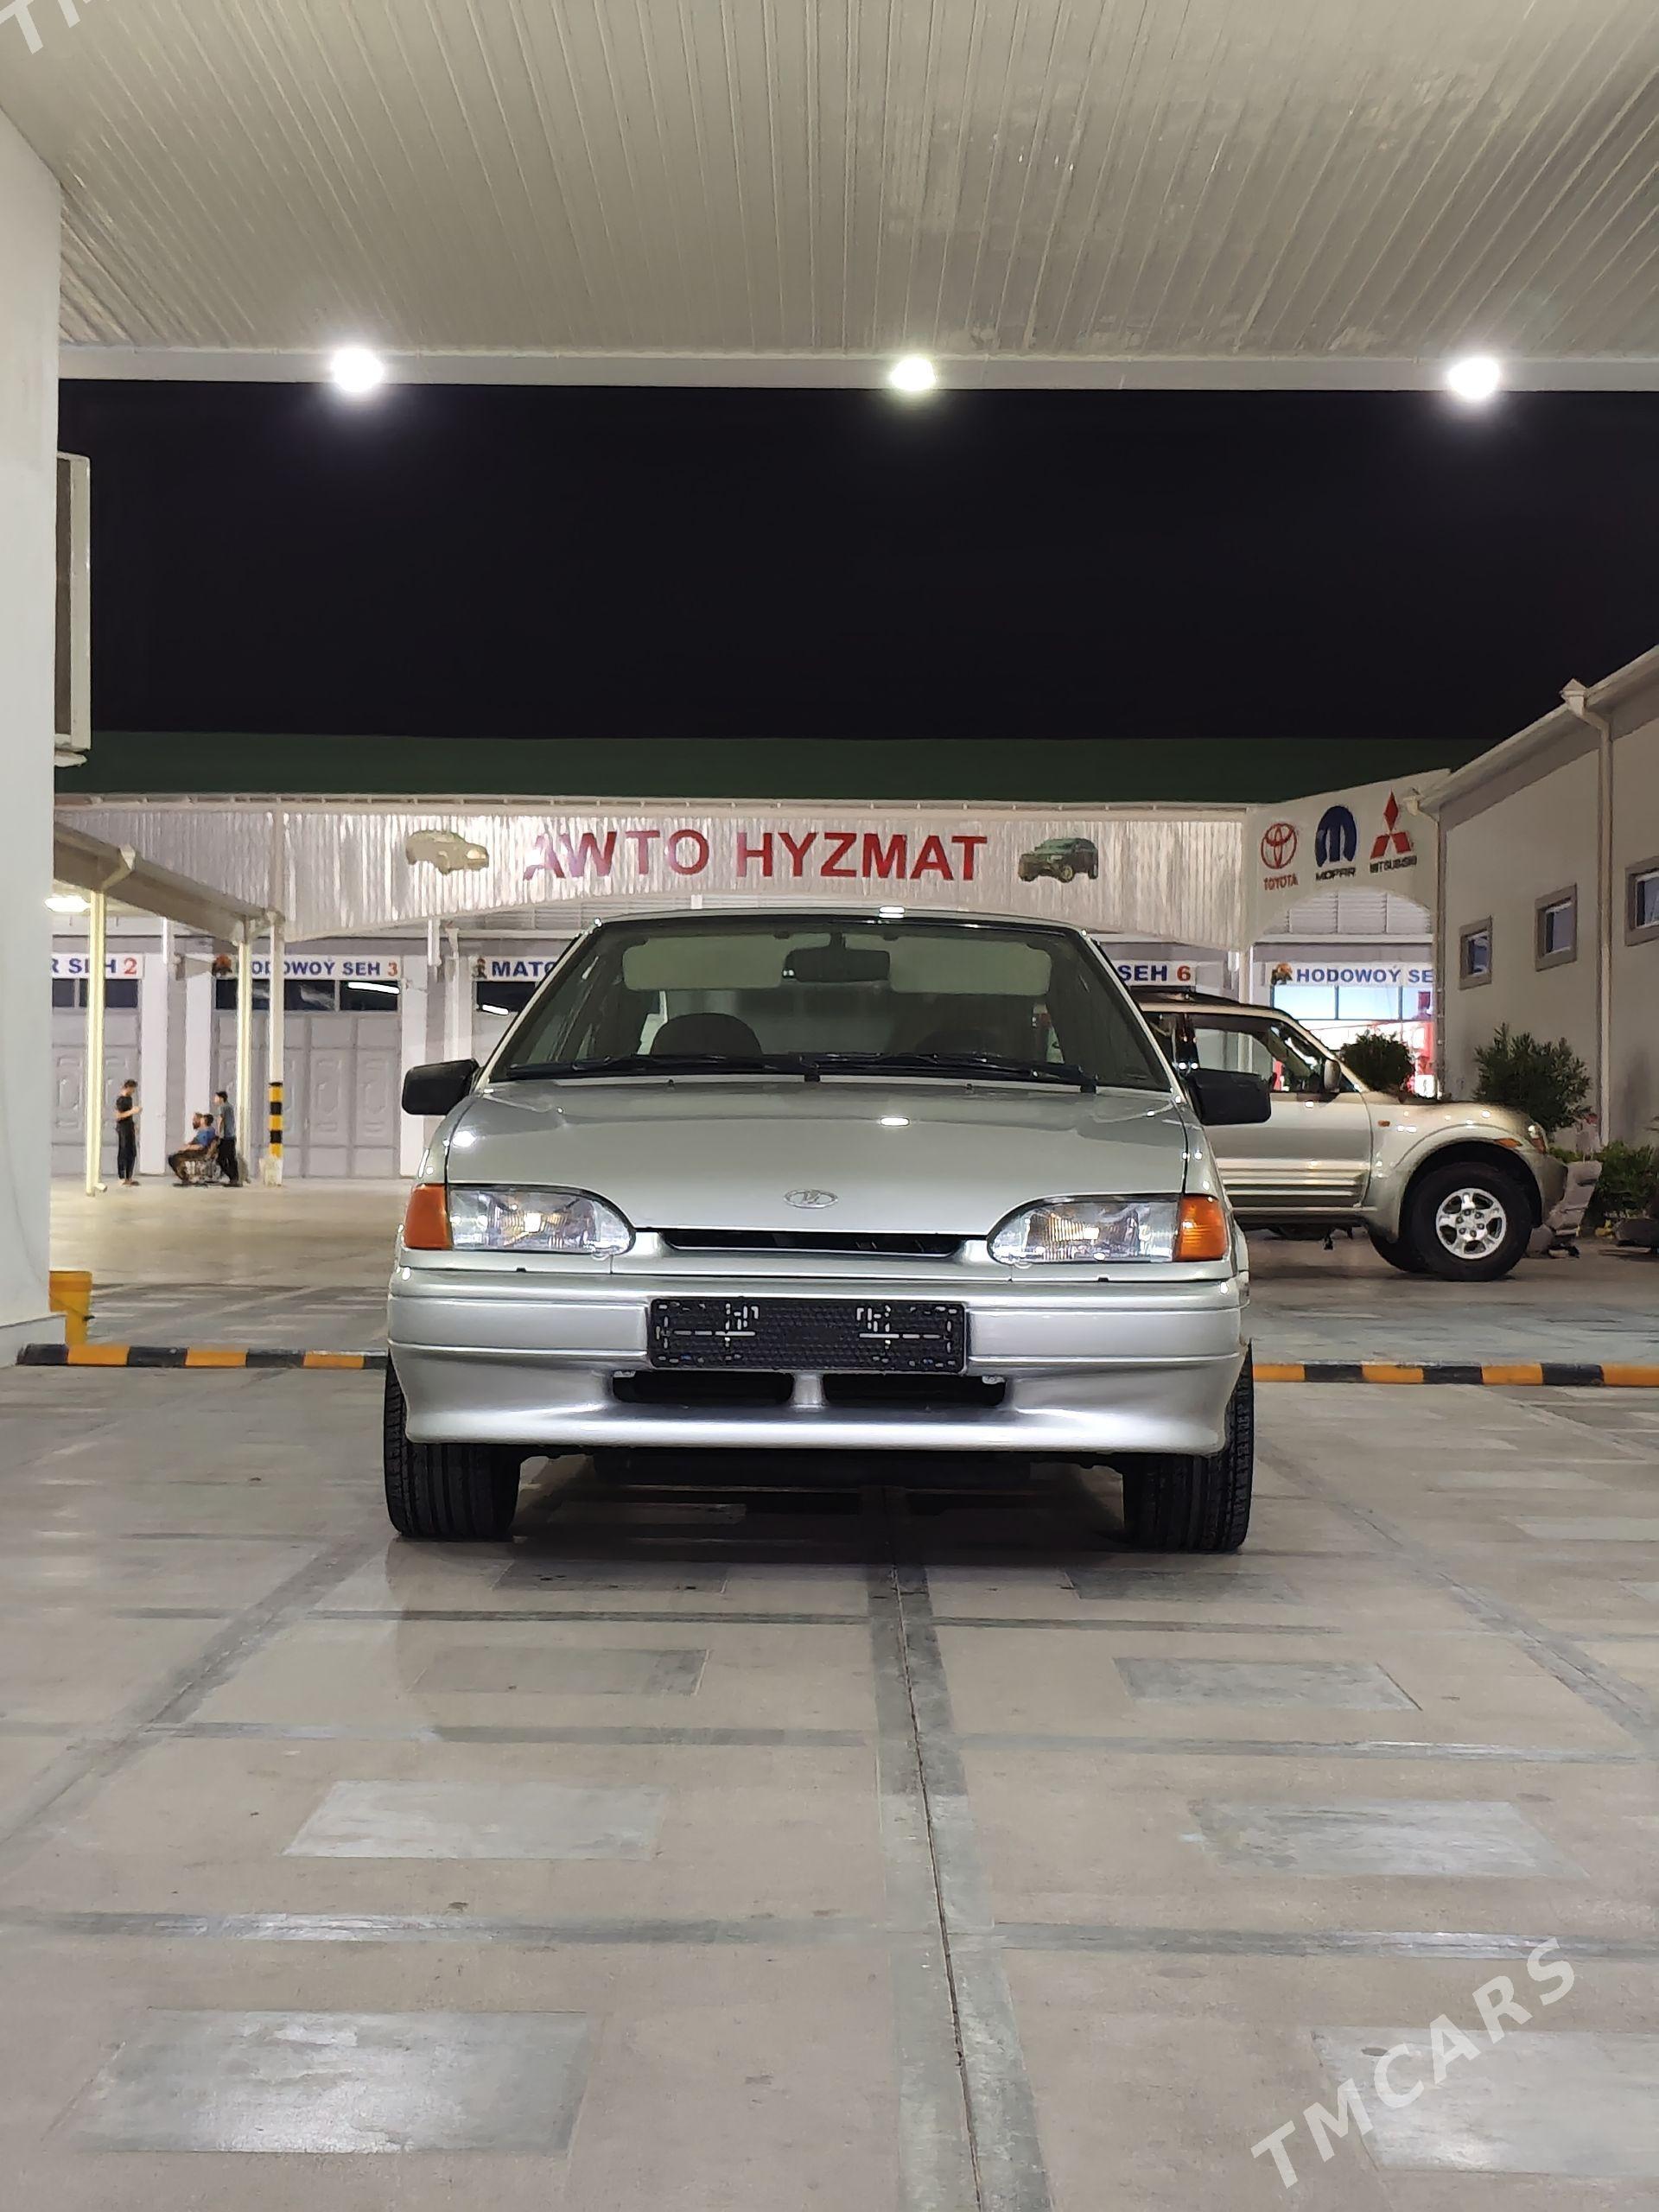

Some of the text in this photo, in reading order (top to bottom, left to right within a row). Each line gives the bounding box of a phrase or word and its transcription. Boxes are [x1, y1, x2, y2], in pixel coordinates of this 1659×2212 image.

[523, 829, 988, 880] AWTO HYZMAT
[1263, 873, 1299, 891] TOYOTA
[1315, 867, 1356, 881] MOPAR
[124, 957, 137, 975] 2
[342, 962, 381, 976] SEH
[387, 962, 398, 976] 3
[1117, 965, 1192, 982] SEH 6
